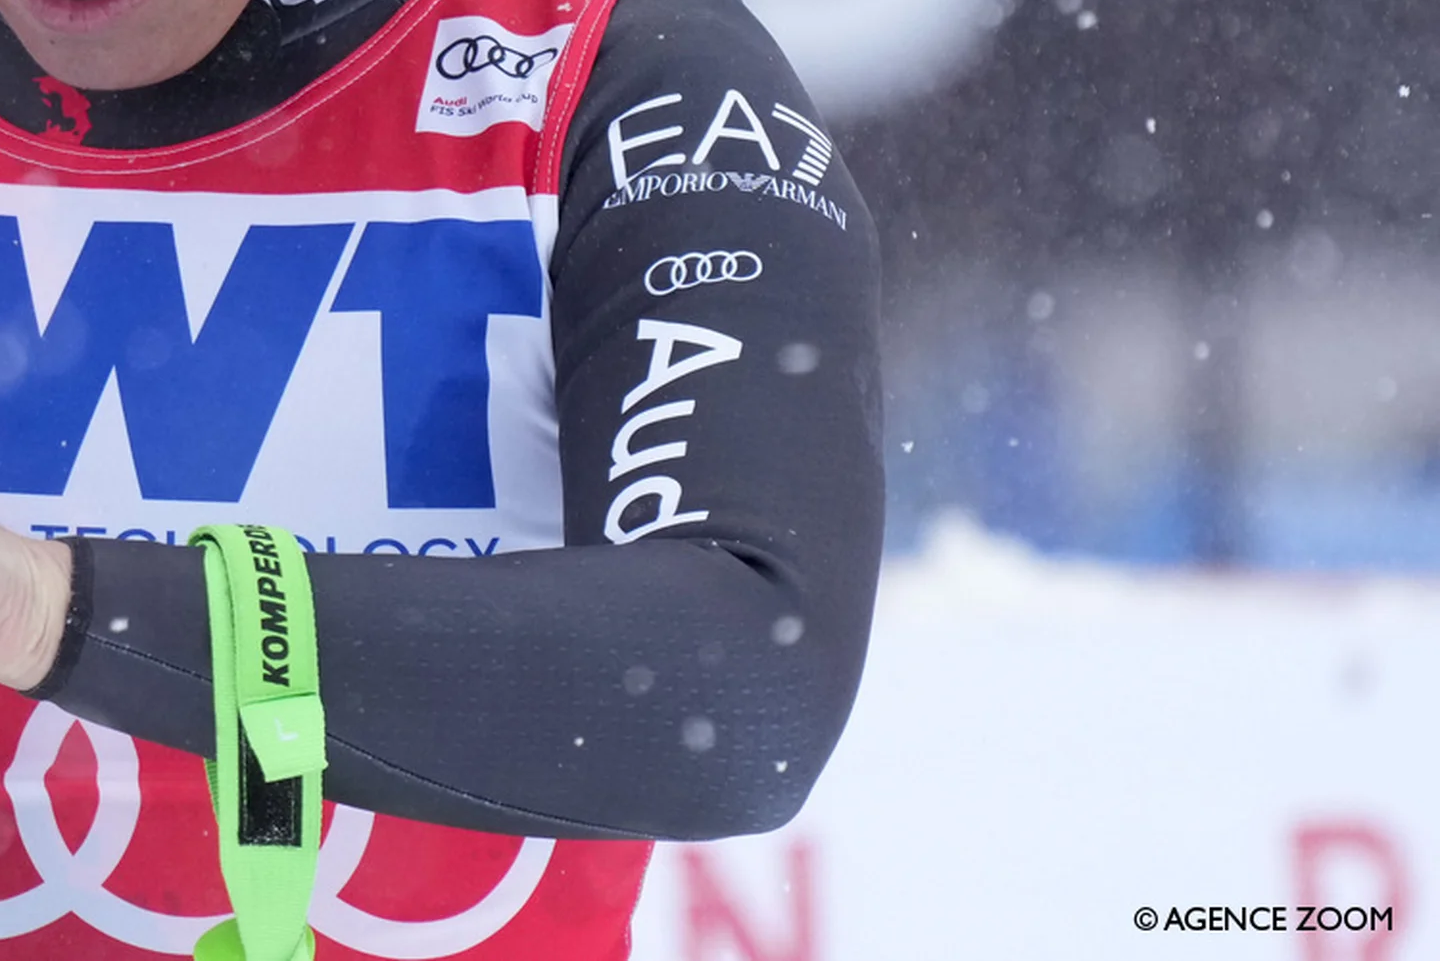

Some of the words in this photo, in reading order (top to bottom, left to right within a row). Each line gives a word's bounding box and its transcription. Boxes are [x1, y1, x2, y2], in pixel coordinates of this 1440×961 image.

[430, 104, 454, 116] FIS
[433, 96, 468, 108] Audi
[608, 89, 832, 187] EA7
[603, 171, 729, 210] EMPORIO
[760, 177, 847, 231] ARMANI
[603, 319, 743, 545] Aud
[242, 523, 290, 687] KOMPERD
